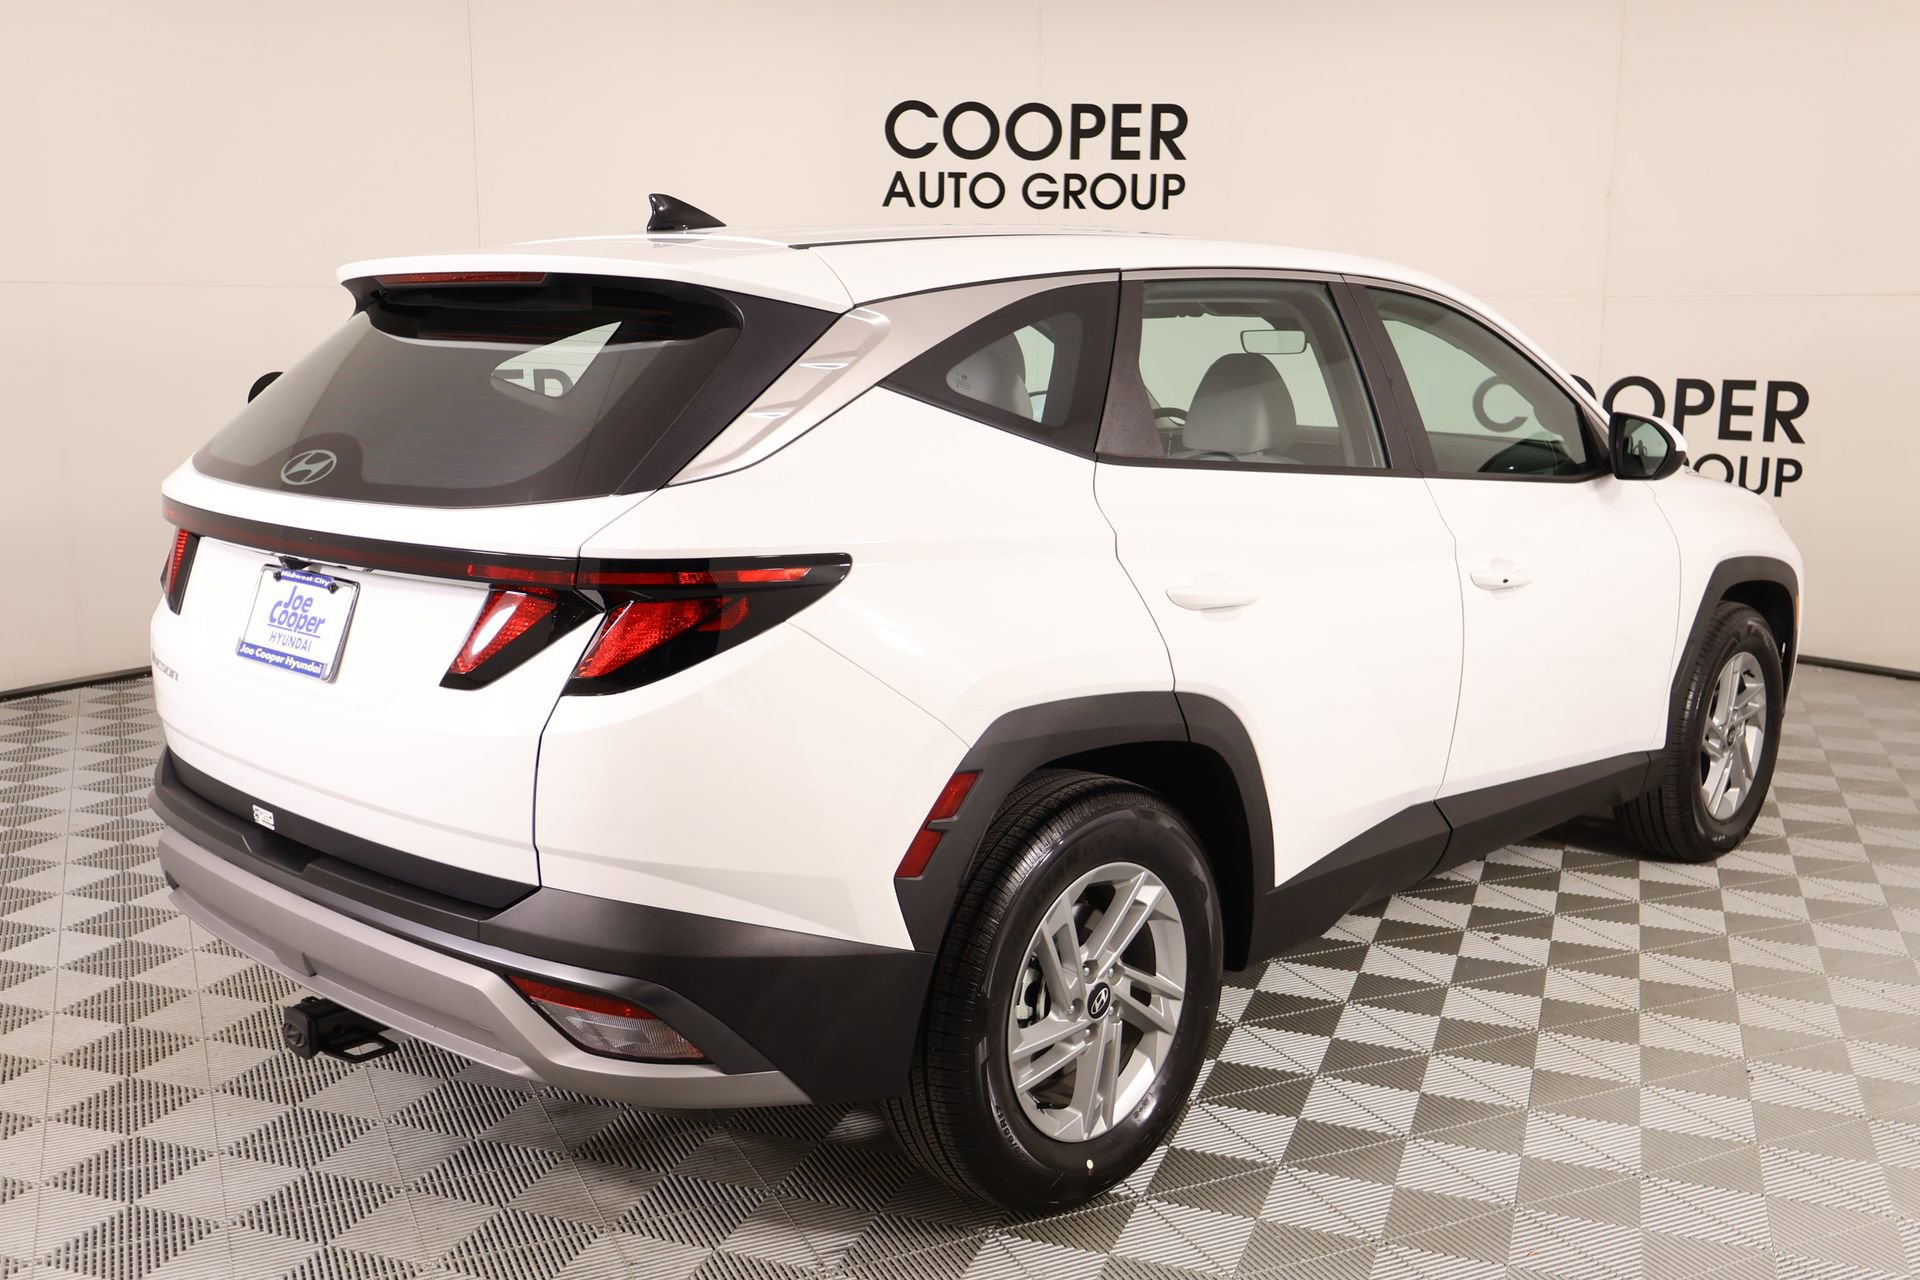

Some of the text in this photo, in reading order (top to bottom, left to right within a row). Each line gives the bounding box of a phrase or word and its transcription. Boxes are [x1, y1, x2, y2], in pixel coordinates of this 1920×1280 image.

[885, 100, 1188, 161] COOPER
[882, 170, 1186, 210] AUTO GROUP
[1473, 374, 1809, 443] COPER
[281, 569, 331, 587] Midwest City
[284, 586, 313, 613] Joe
[269, 601, 326, 633] Cooper
[269, 631, 312, 653] HYUNDAI
[240, 644, 322, 674] Joe Cooper Hyundai
